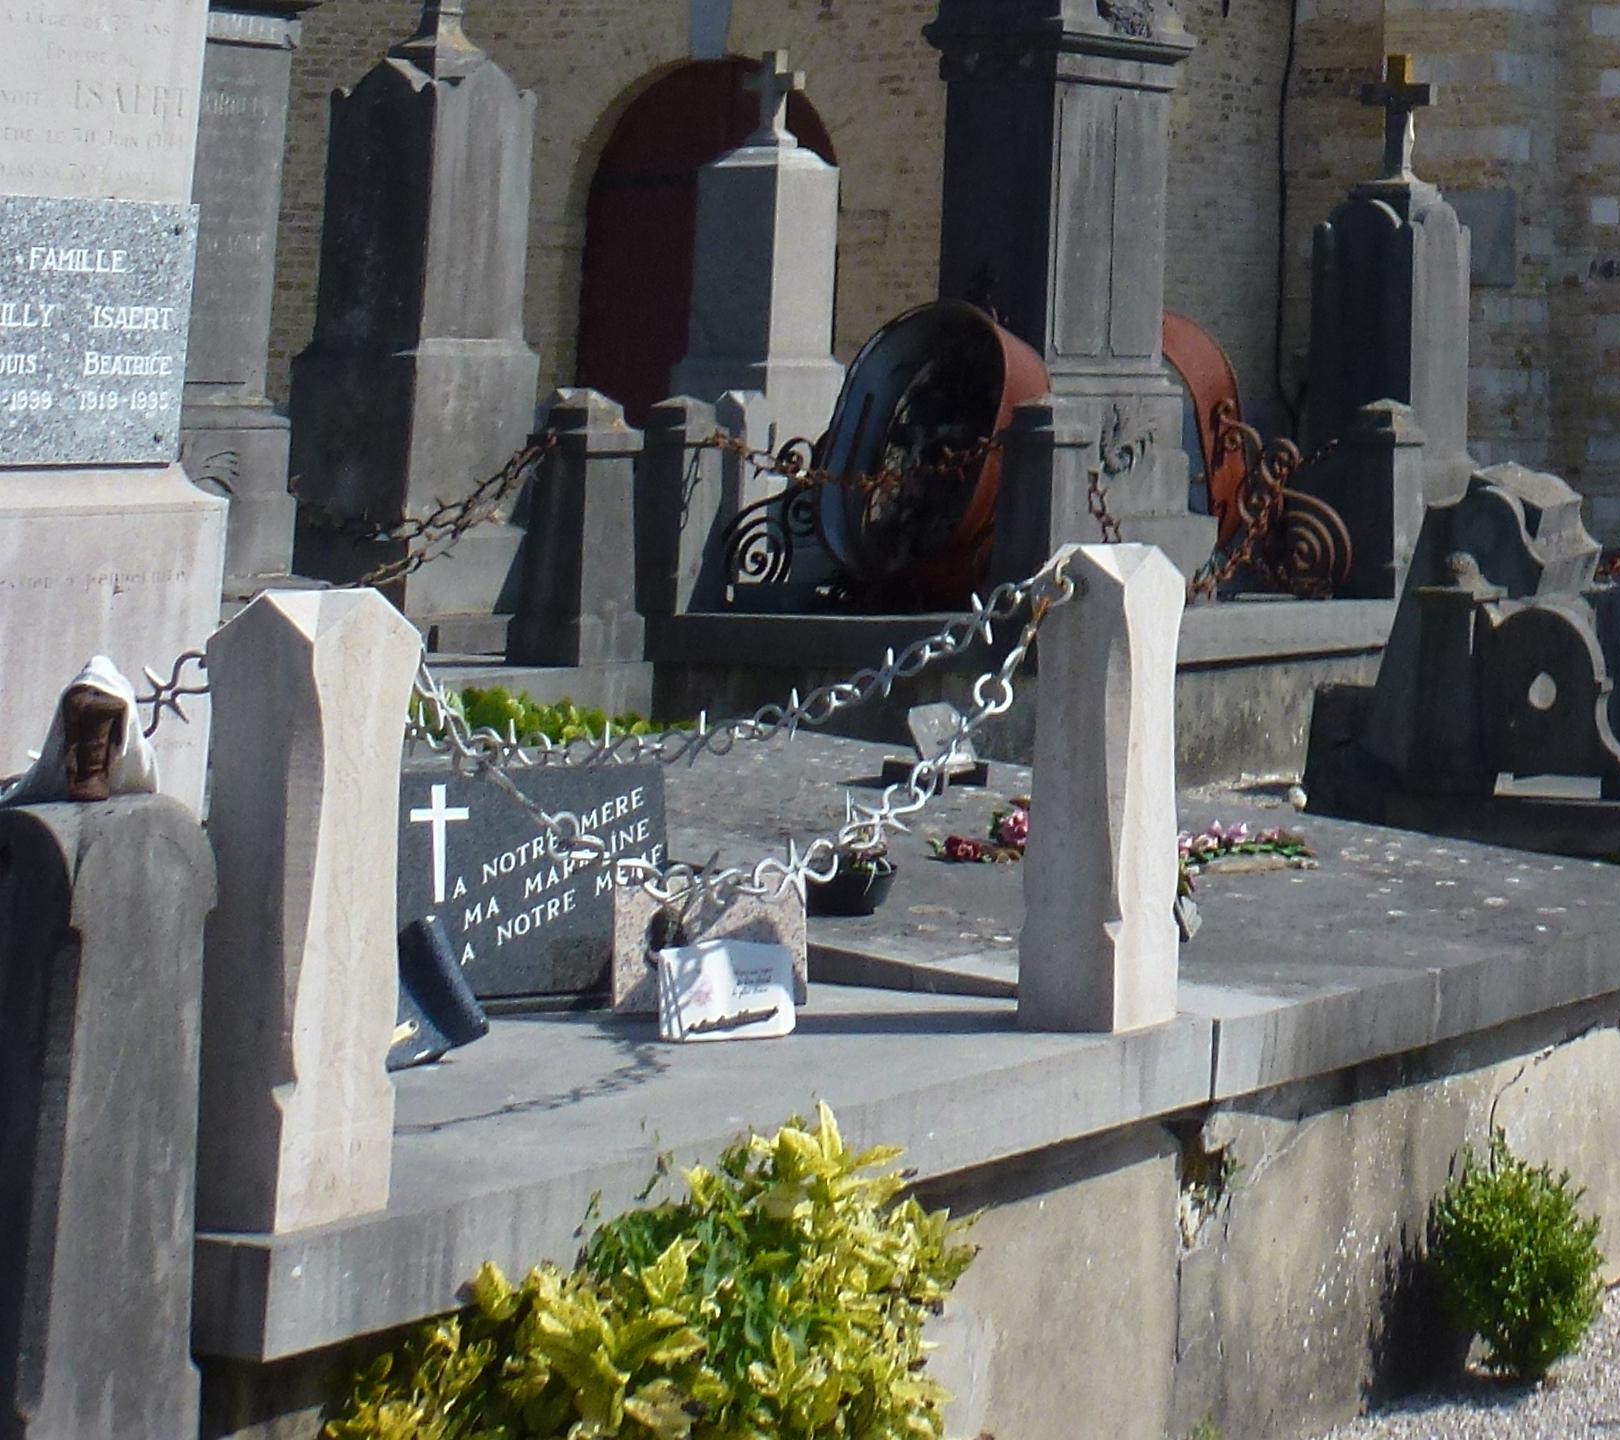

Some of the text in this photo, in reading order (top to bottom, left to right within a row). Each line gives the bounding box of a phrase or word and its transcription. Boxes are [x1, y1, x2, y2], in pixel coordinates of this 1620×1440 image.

[28, 246, 128, 274] FAMILLE
[92, 305, 174, 331] ISAERT
[452, 876, 469, 903] A
[580, 786, 645, 834] MERE
[463, 817, 650, 932] MA MARINE
[460, 941, 476, 967] A
[496, 889, 577, 947] NOTRE
